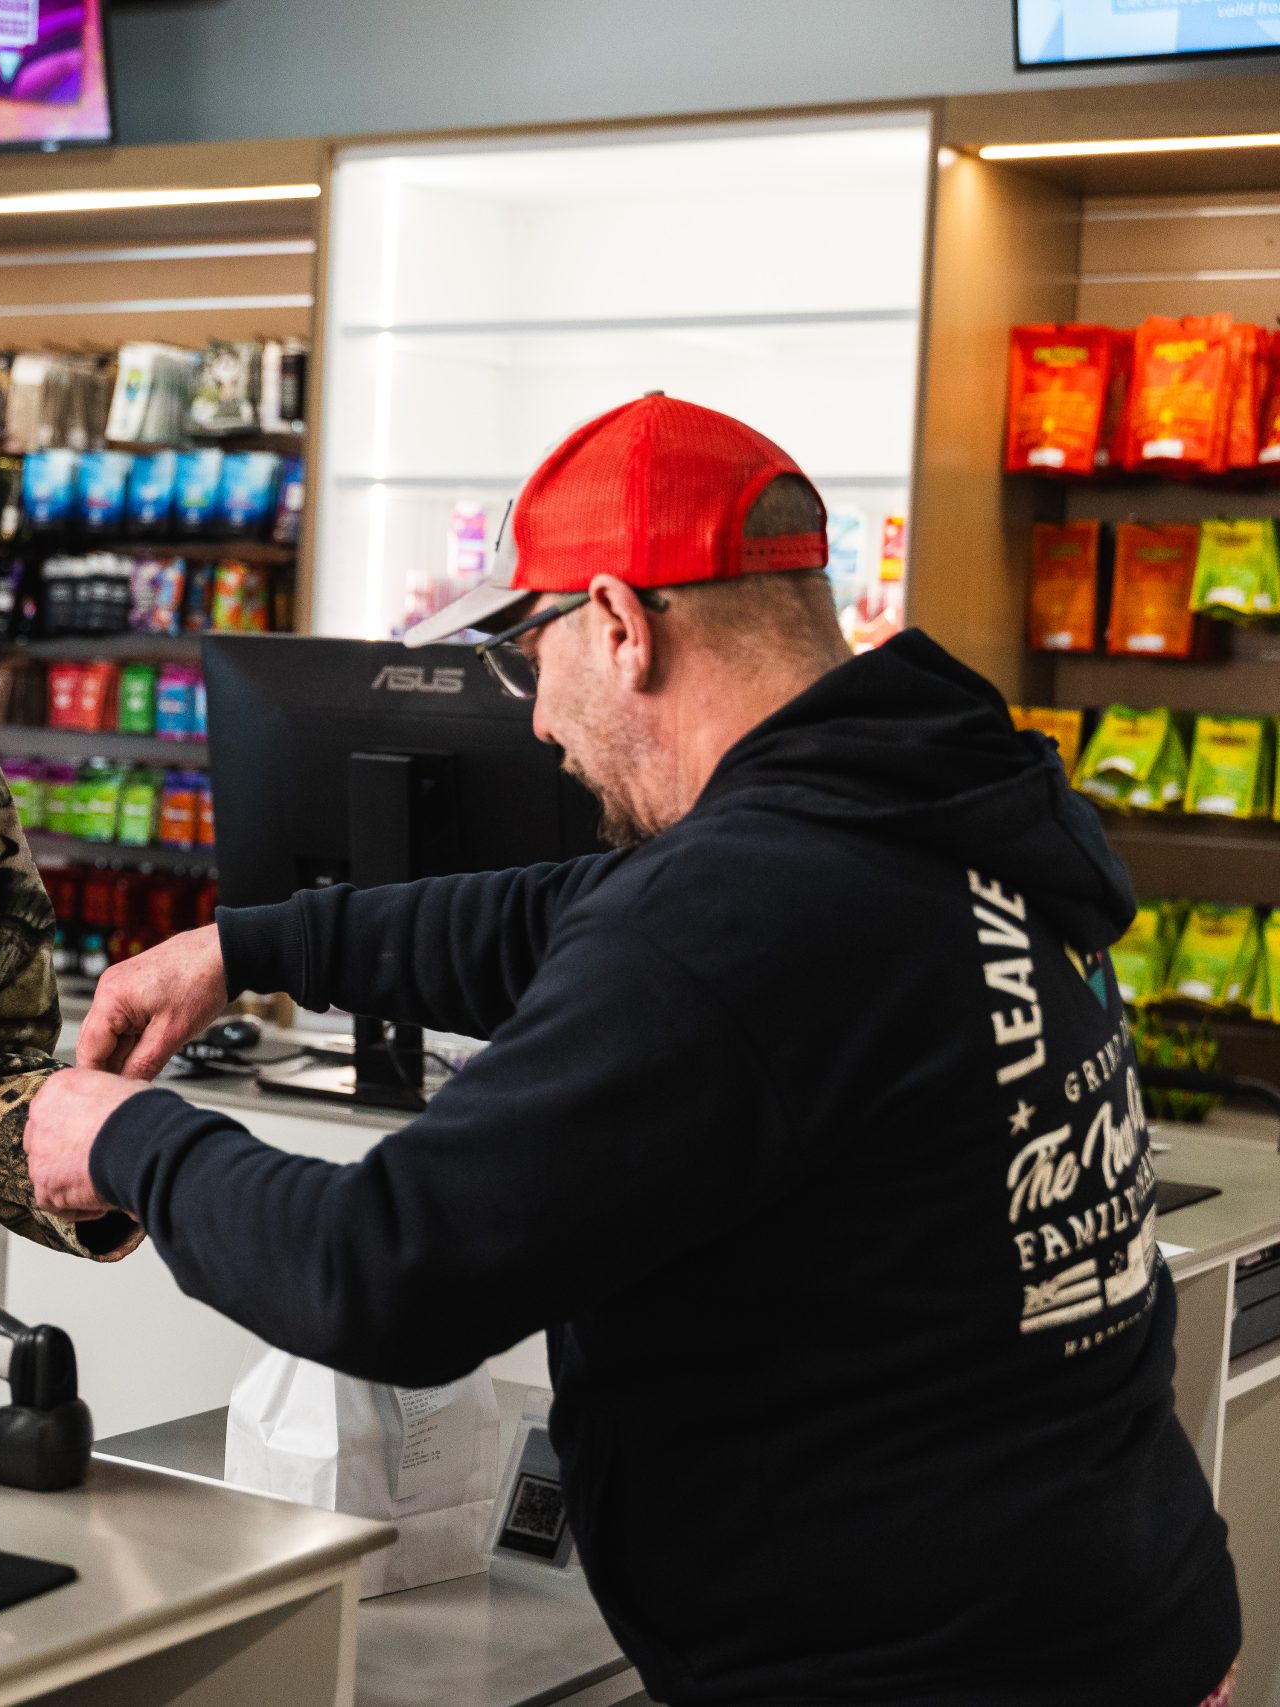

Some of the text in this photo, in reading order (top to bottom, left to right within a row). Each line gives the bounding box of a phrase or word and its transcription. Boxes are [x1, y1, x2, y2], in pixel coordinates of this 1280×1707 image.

[370, 665, 465, 693] ASUS
[967, 868, 1047, 1087] LEAVE
[1006, 1123, 1081, 1224] The
